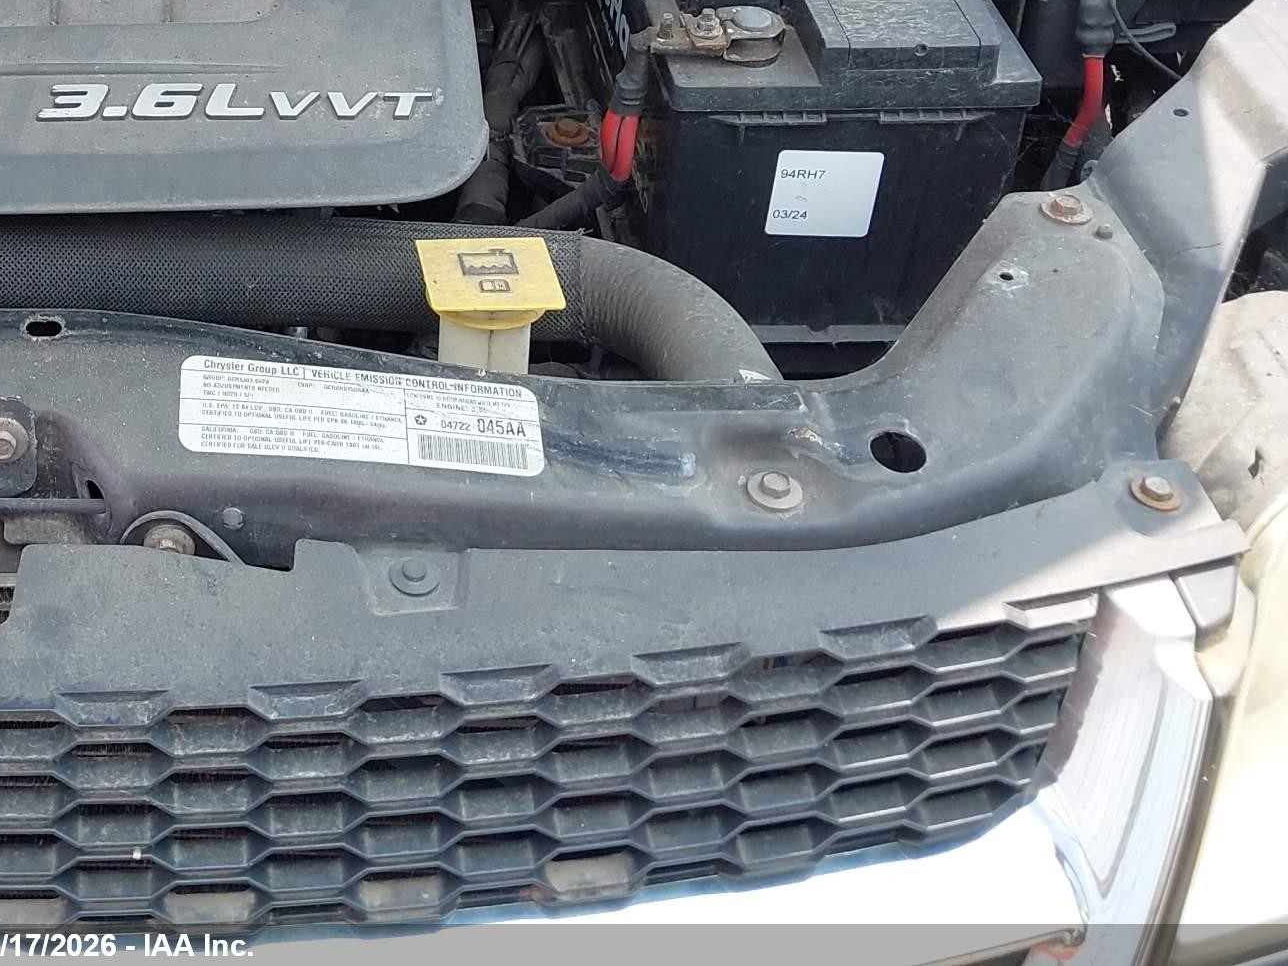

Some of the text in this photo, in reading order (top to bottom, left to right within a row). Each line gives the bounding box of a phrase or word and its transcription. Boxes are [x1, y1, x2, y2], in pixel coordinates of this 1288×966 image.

[36, 83, 434, 122] 3.6L VVT
[780, 168, 826, 180] 94RH7
[772, 209, 808, 220] 03/24
[203, 359, 300, 376] Chrysler Group LLC
[312, 369, 523, 399] VEHICLE EMISSION CONTROL INFORMATION
[440, 419, 472, 432] 04722
